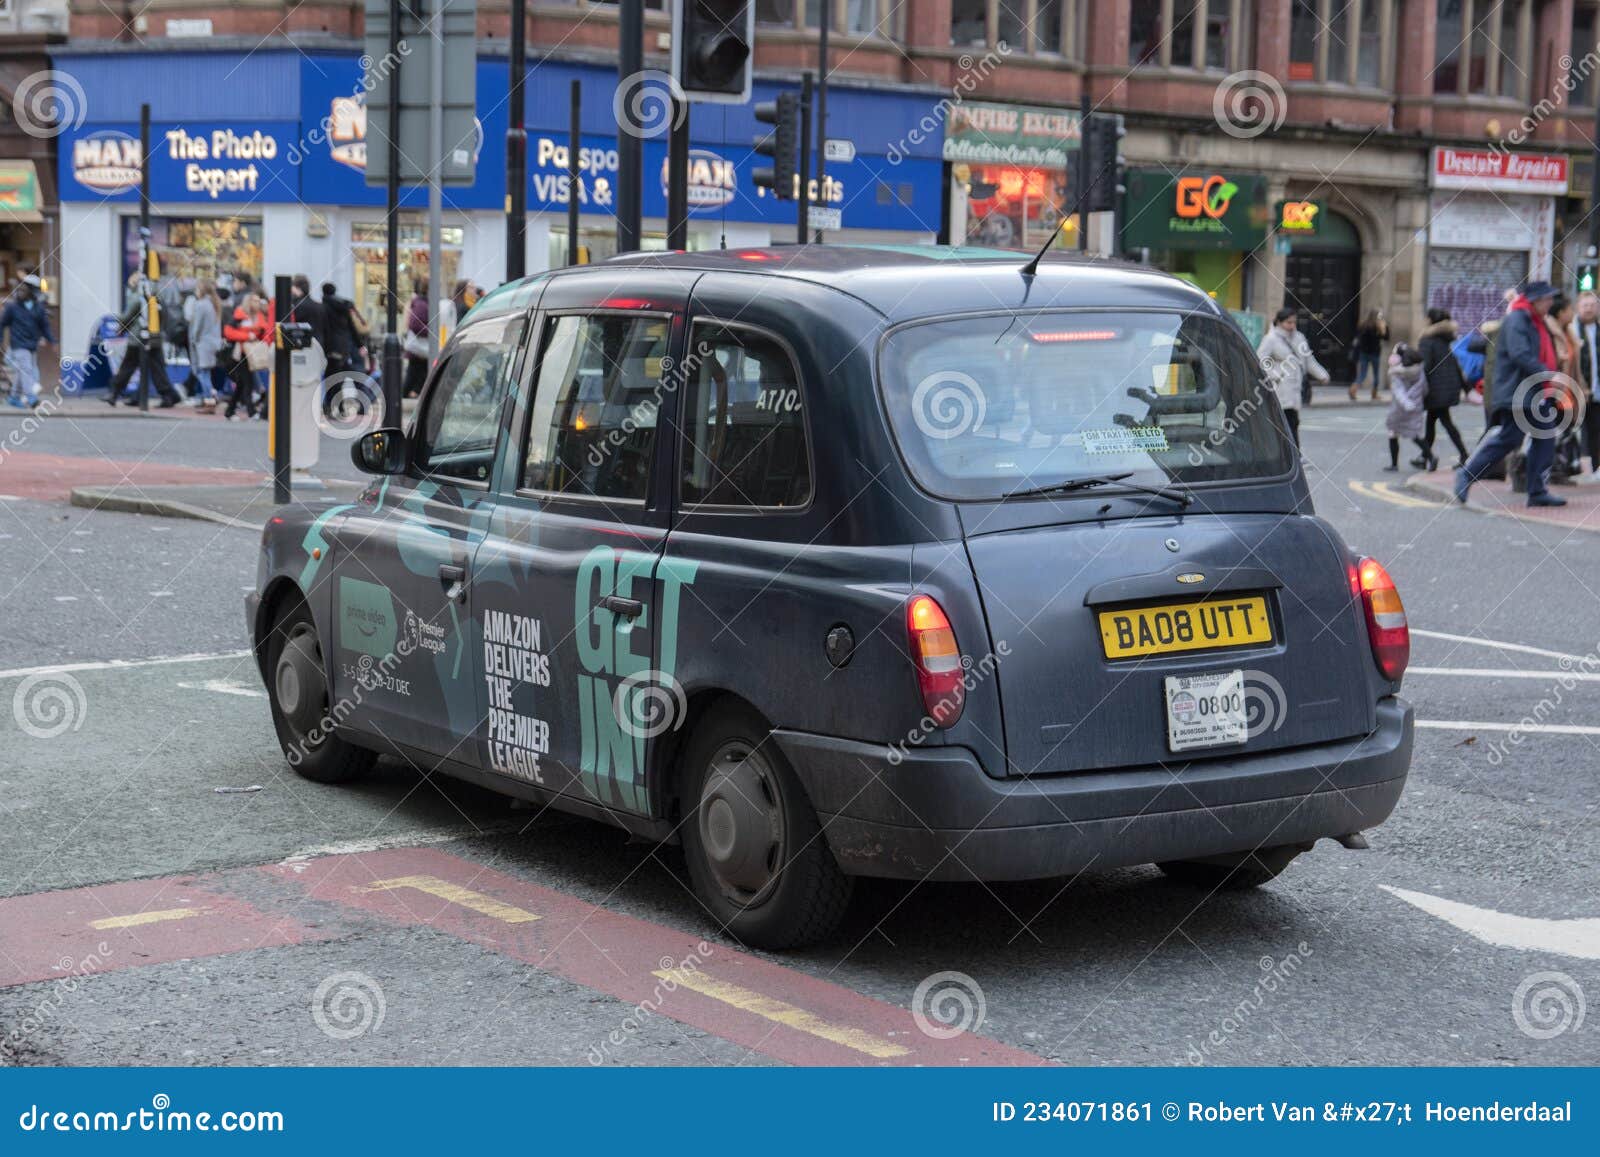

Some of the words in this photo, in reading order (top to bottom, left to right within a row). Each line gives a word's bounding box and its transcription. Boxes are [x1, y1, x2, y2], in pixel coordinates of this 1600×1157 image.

[75, 139, 142, 169] MAX
[166, 129, 208, 159] The
[212, 129, 277, 159] Photo
[538, 138, 619, 177] Paspo
[186, 163, 259, 199] Expert
[663, 157, 734, 189] AX
[1506, 154, 1560, 181] Repairs
[593, 177, 613, 205] &
[1176, 175, 1231, 218] GO
[1102, 430, 1121, 440] TAXI
[419, 617, 444, 637] Premier
[484, 609, 541, 651] AMAZON
[575, 544, 700, 688] GET
[1113, 609, 1194, 650] BA08
[1200, 603, 1253, 640] UTT
[420, 637, 446, 654] League
[485, 643, 550, 687] DELIVERS
[396, 679, 411, 696] DEC
[485, 675, 514, 711] THE
[1200, 693, 1241, 716] 0800
[488, 709, 550, 754] PREMIER
[577, 674, 652, 816] IN!
[488, 740, 545, 784] LEAGUE
